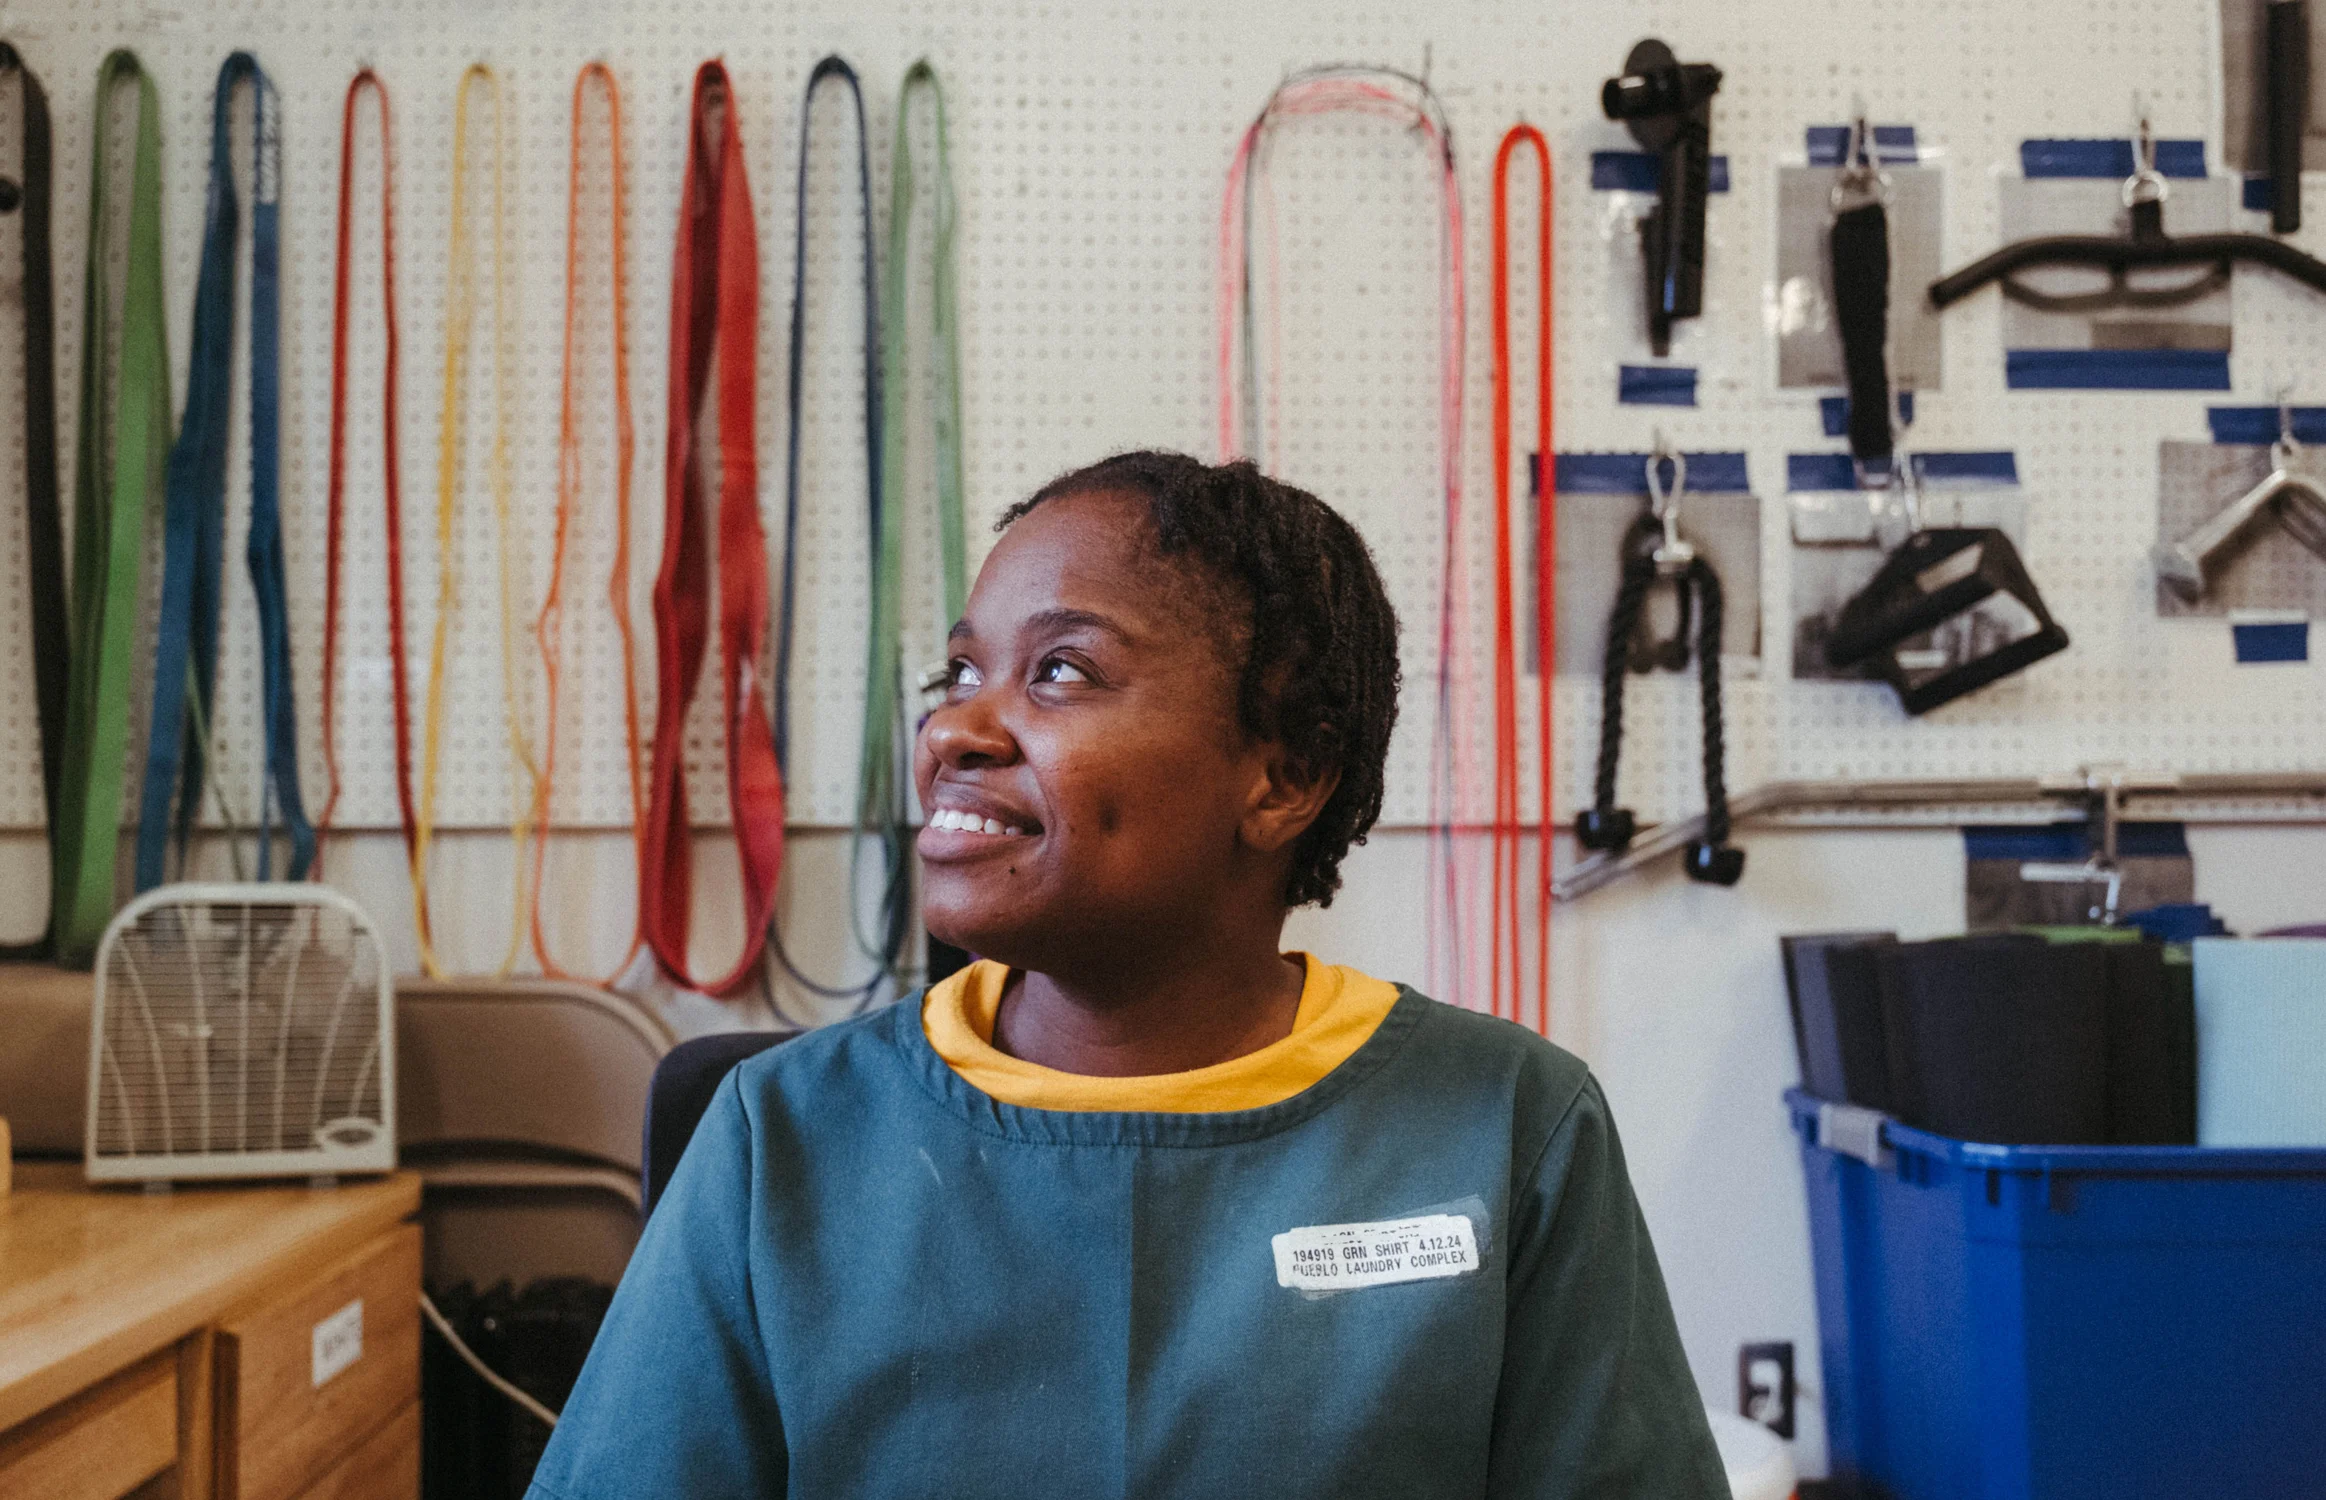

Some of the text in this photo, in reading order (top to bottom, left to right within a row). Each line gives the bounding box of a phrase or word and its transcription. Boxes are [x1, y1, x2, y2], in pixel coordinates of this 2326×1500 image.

[1293, 1248, 1335, 1262] 194919
[1343, 1246, 1368, 1260] GRN
[1375, 1241, 1409, 1257] SHIRT
[1419, 1235, 1462, 1251] 4.12.24
[1347, 1257, 1401, 1275] LAUNDRY
[1411, 1250, 1467, 1268] COMPLEX
